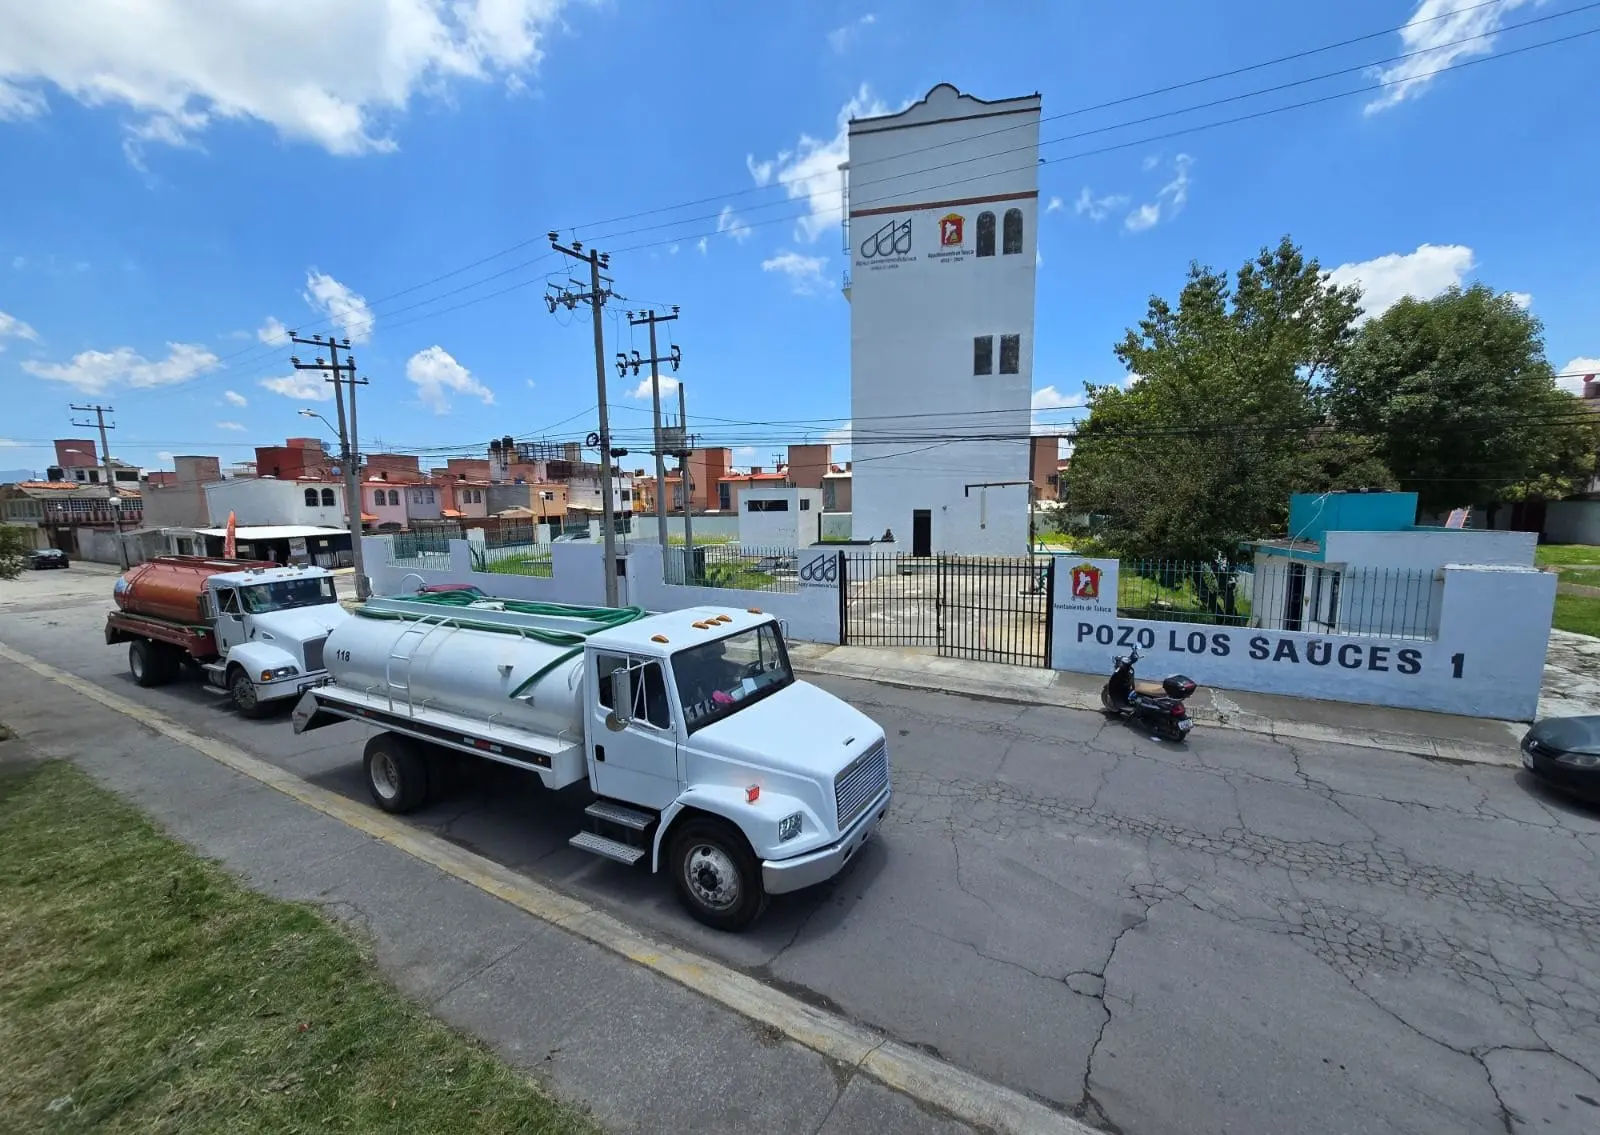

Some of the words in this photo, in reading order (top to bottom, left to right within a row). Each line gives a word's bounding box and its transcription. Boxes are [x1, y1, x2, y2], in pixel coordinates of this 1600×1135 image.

[336, 649, 351, 662] 118
[1077, 622, 1155, 649] POZO
[1169, 630, 1230, 656] LOS
[1249, 636, 1423, 675] SAUCES
[1451, 653, 1465, 679] 1
